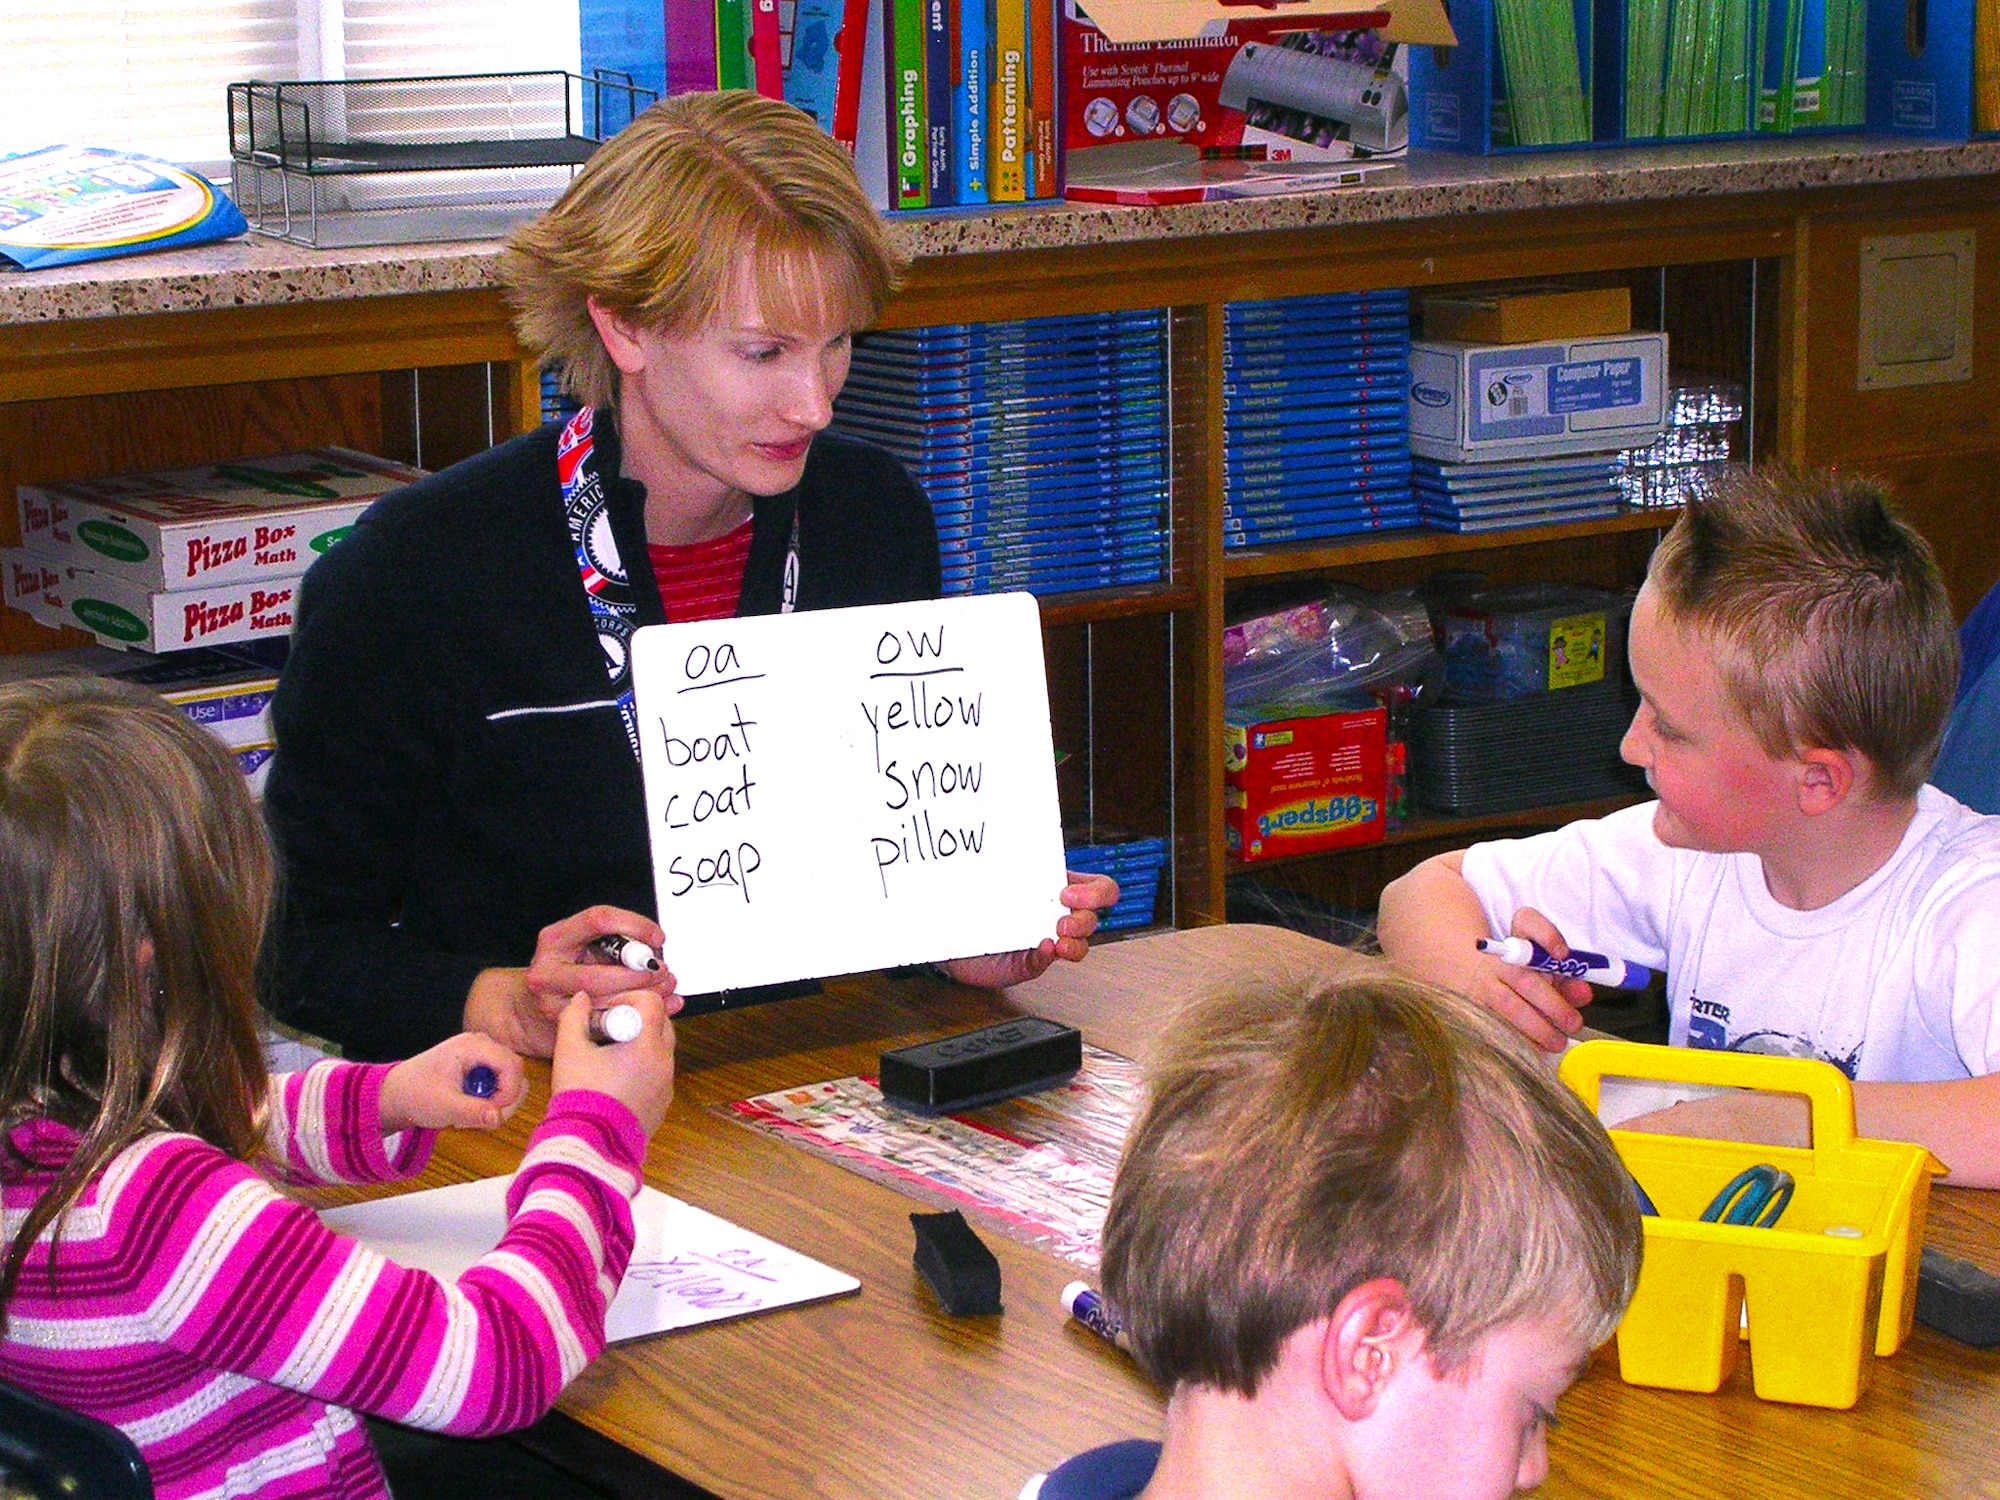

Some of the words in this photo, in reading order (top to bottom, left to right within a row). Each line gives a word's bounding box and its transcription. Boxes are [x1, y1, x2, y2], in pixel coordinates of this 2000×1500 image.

[969, 49, 979, 115] Addition
[1001, 50, 1020, 163] Patterning
[901, 69, 919, 167] Graphing
[969, 118, 982, 172] Simple
[1271, 149, 1292, 161] 3M
[1557, 364, 1601, 382] Computer
[187, 536, 247, 577] Pizza
[254, 524, 296, 551] Box
[254, 549, 296, 565] Math
[183, 601, 243, 642] Pizza
[250, 589, 292, 615] Box
[250, 612, 292, 630] Math
[685, 643, 740, 680] oa
[876, 625, 944, 664] ow
[659, 703, 757, 767] boat
[861, 680, 982, 773] yellow
[665, 764, 756, 828] coat
[1257, 795, 1378, 837] Eggspert
[669, 842, 761, 904] soap
[871, 809, 985, 899] pillow
